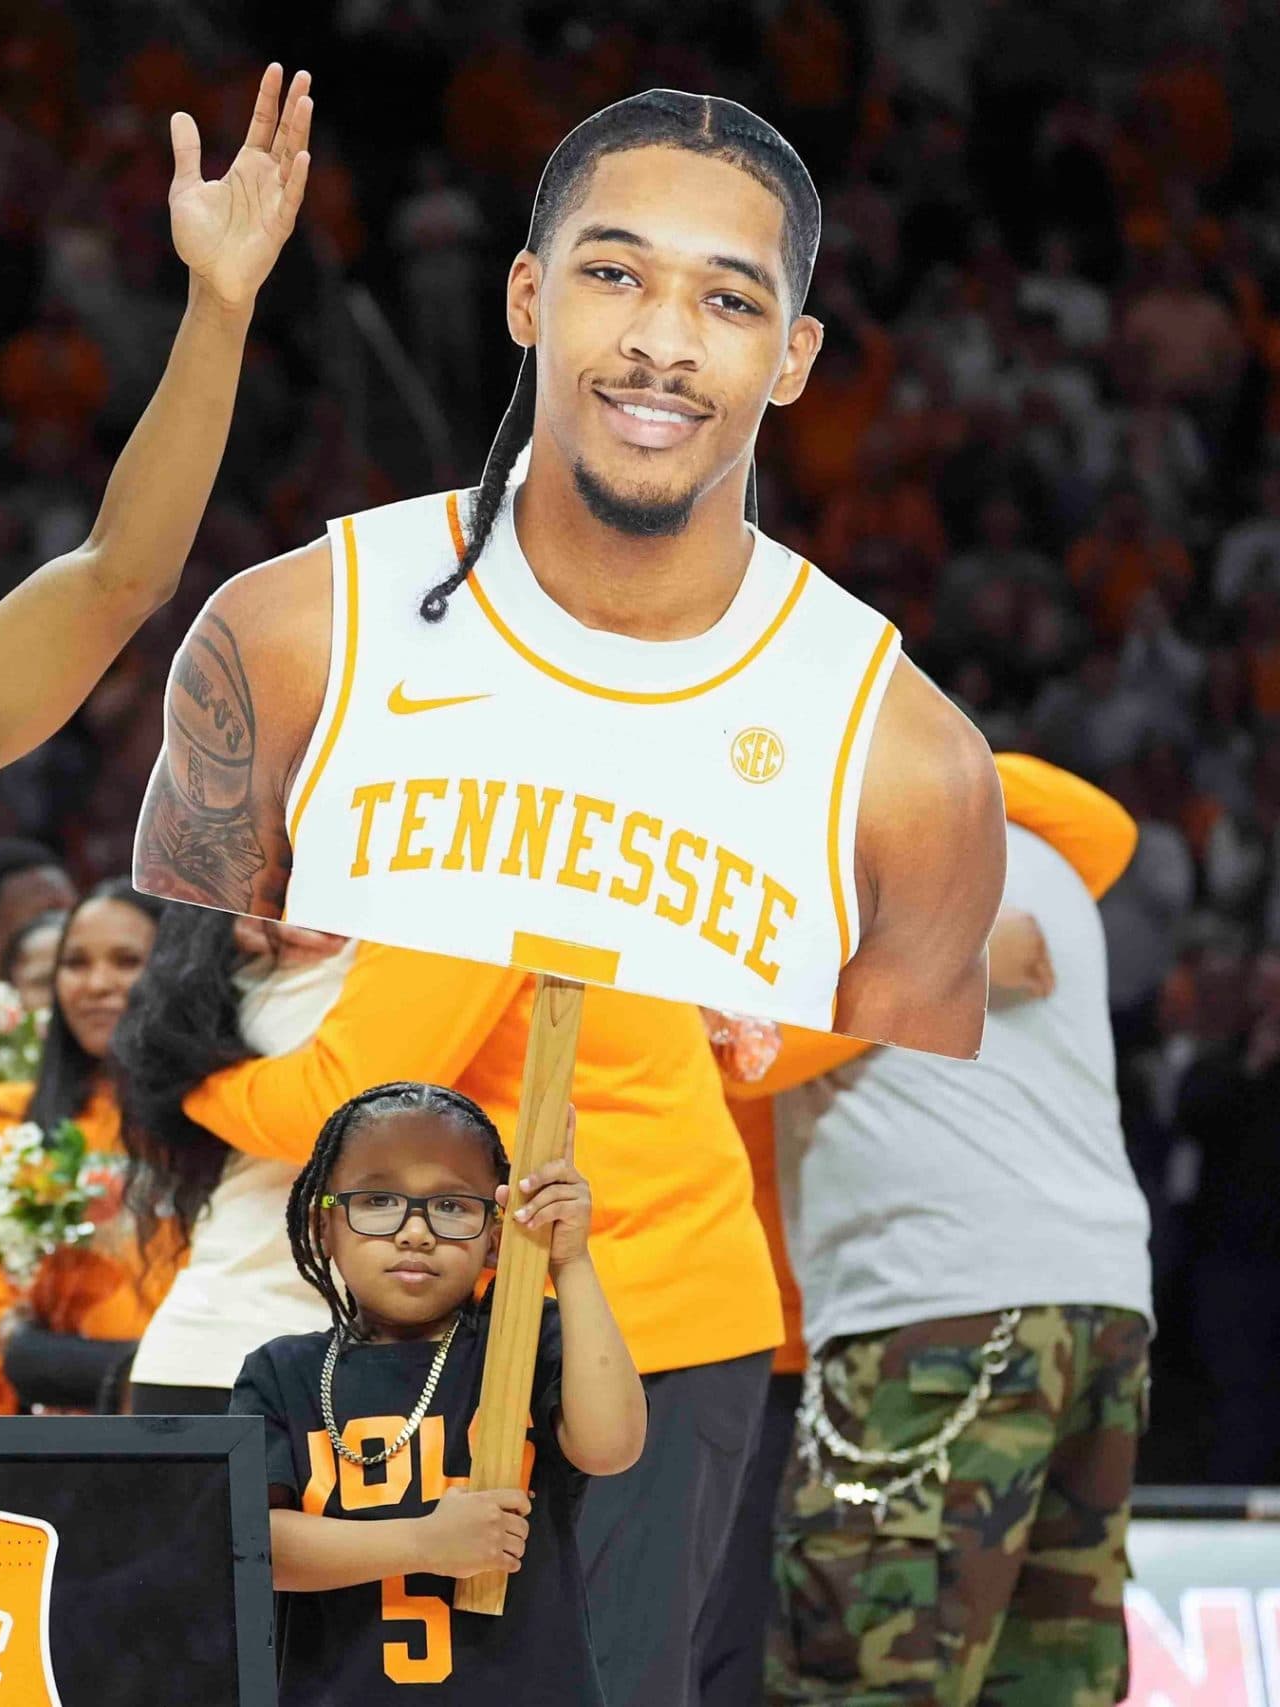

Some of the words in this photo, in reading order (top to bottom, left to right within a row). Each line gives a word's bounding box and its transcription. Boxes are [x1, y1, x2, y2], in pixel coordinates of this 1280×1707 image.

[736, 731, 781, 778] SEC
[350, 778, 798, 986] TENNESSEE
[381, 1575, 453, 1685] 5
